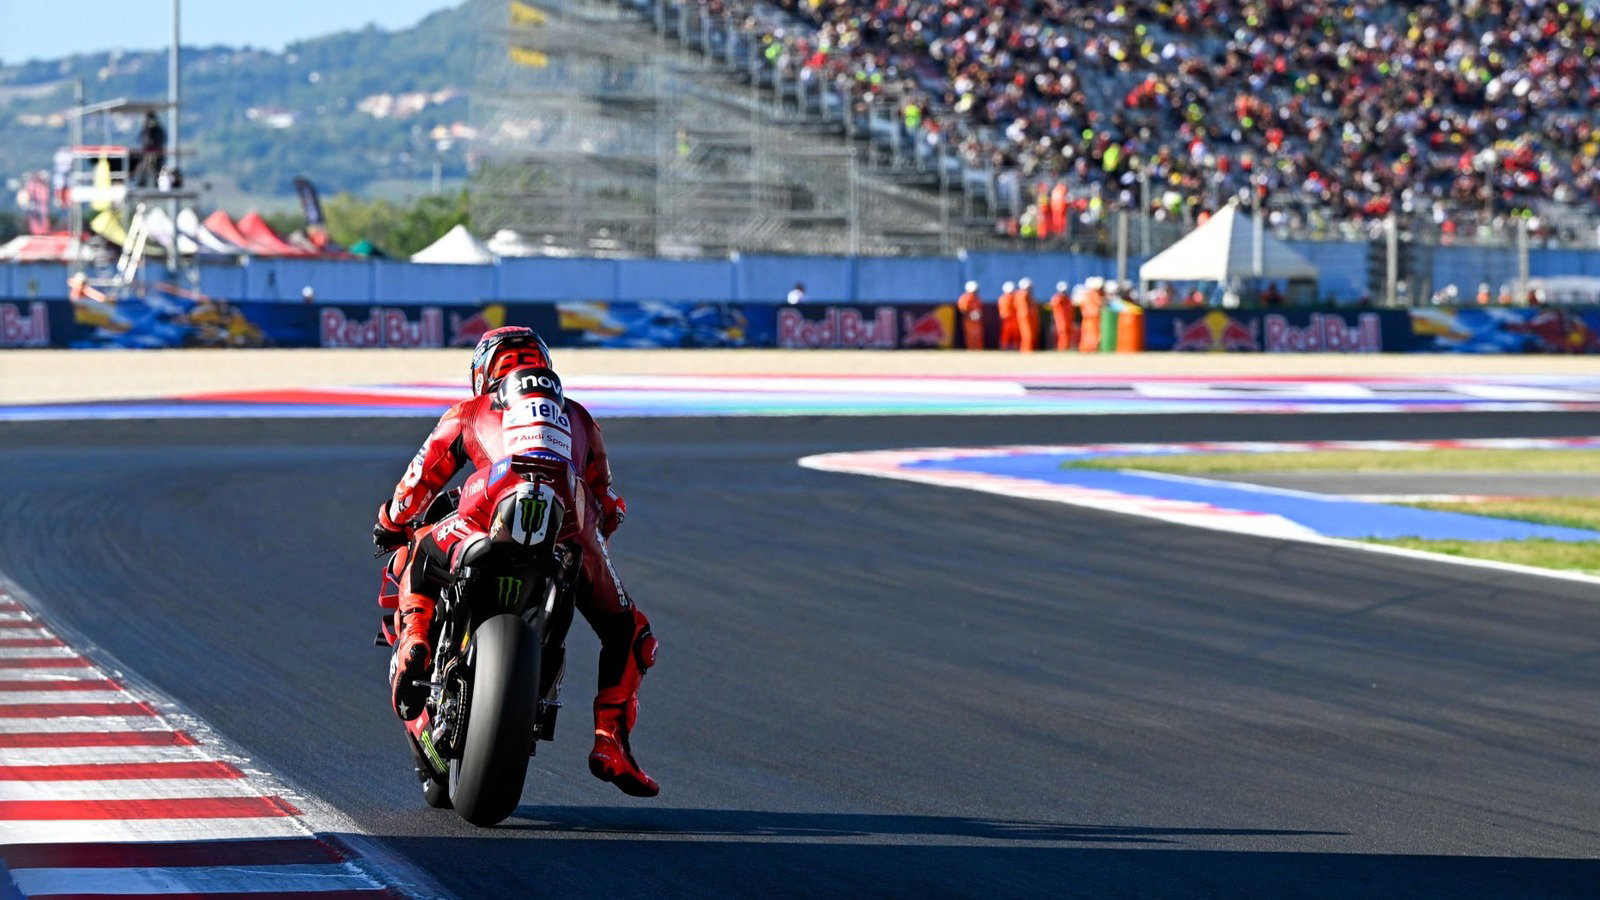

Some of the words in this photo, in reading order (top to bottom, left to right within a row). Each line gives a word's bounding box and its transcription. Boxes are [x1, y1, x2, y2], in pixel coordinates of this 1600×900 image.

[0, 303, 49, 345] Bull
[320, 307, 383, 346] Red
[384, 307, 443, 346] Bull
[777, 307, 839, 347] Red
[840, 307, 896, 347] Bull
[1264, 313, 1322, 351] Red
[1323, 313, 1381, 351] Bull
[520, 433, 544, 441] Audi
[546, 435, 570, 452] Sport
